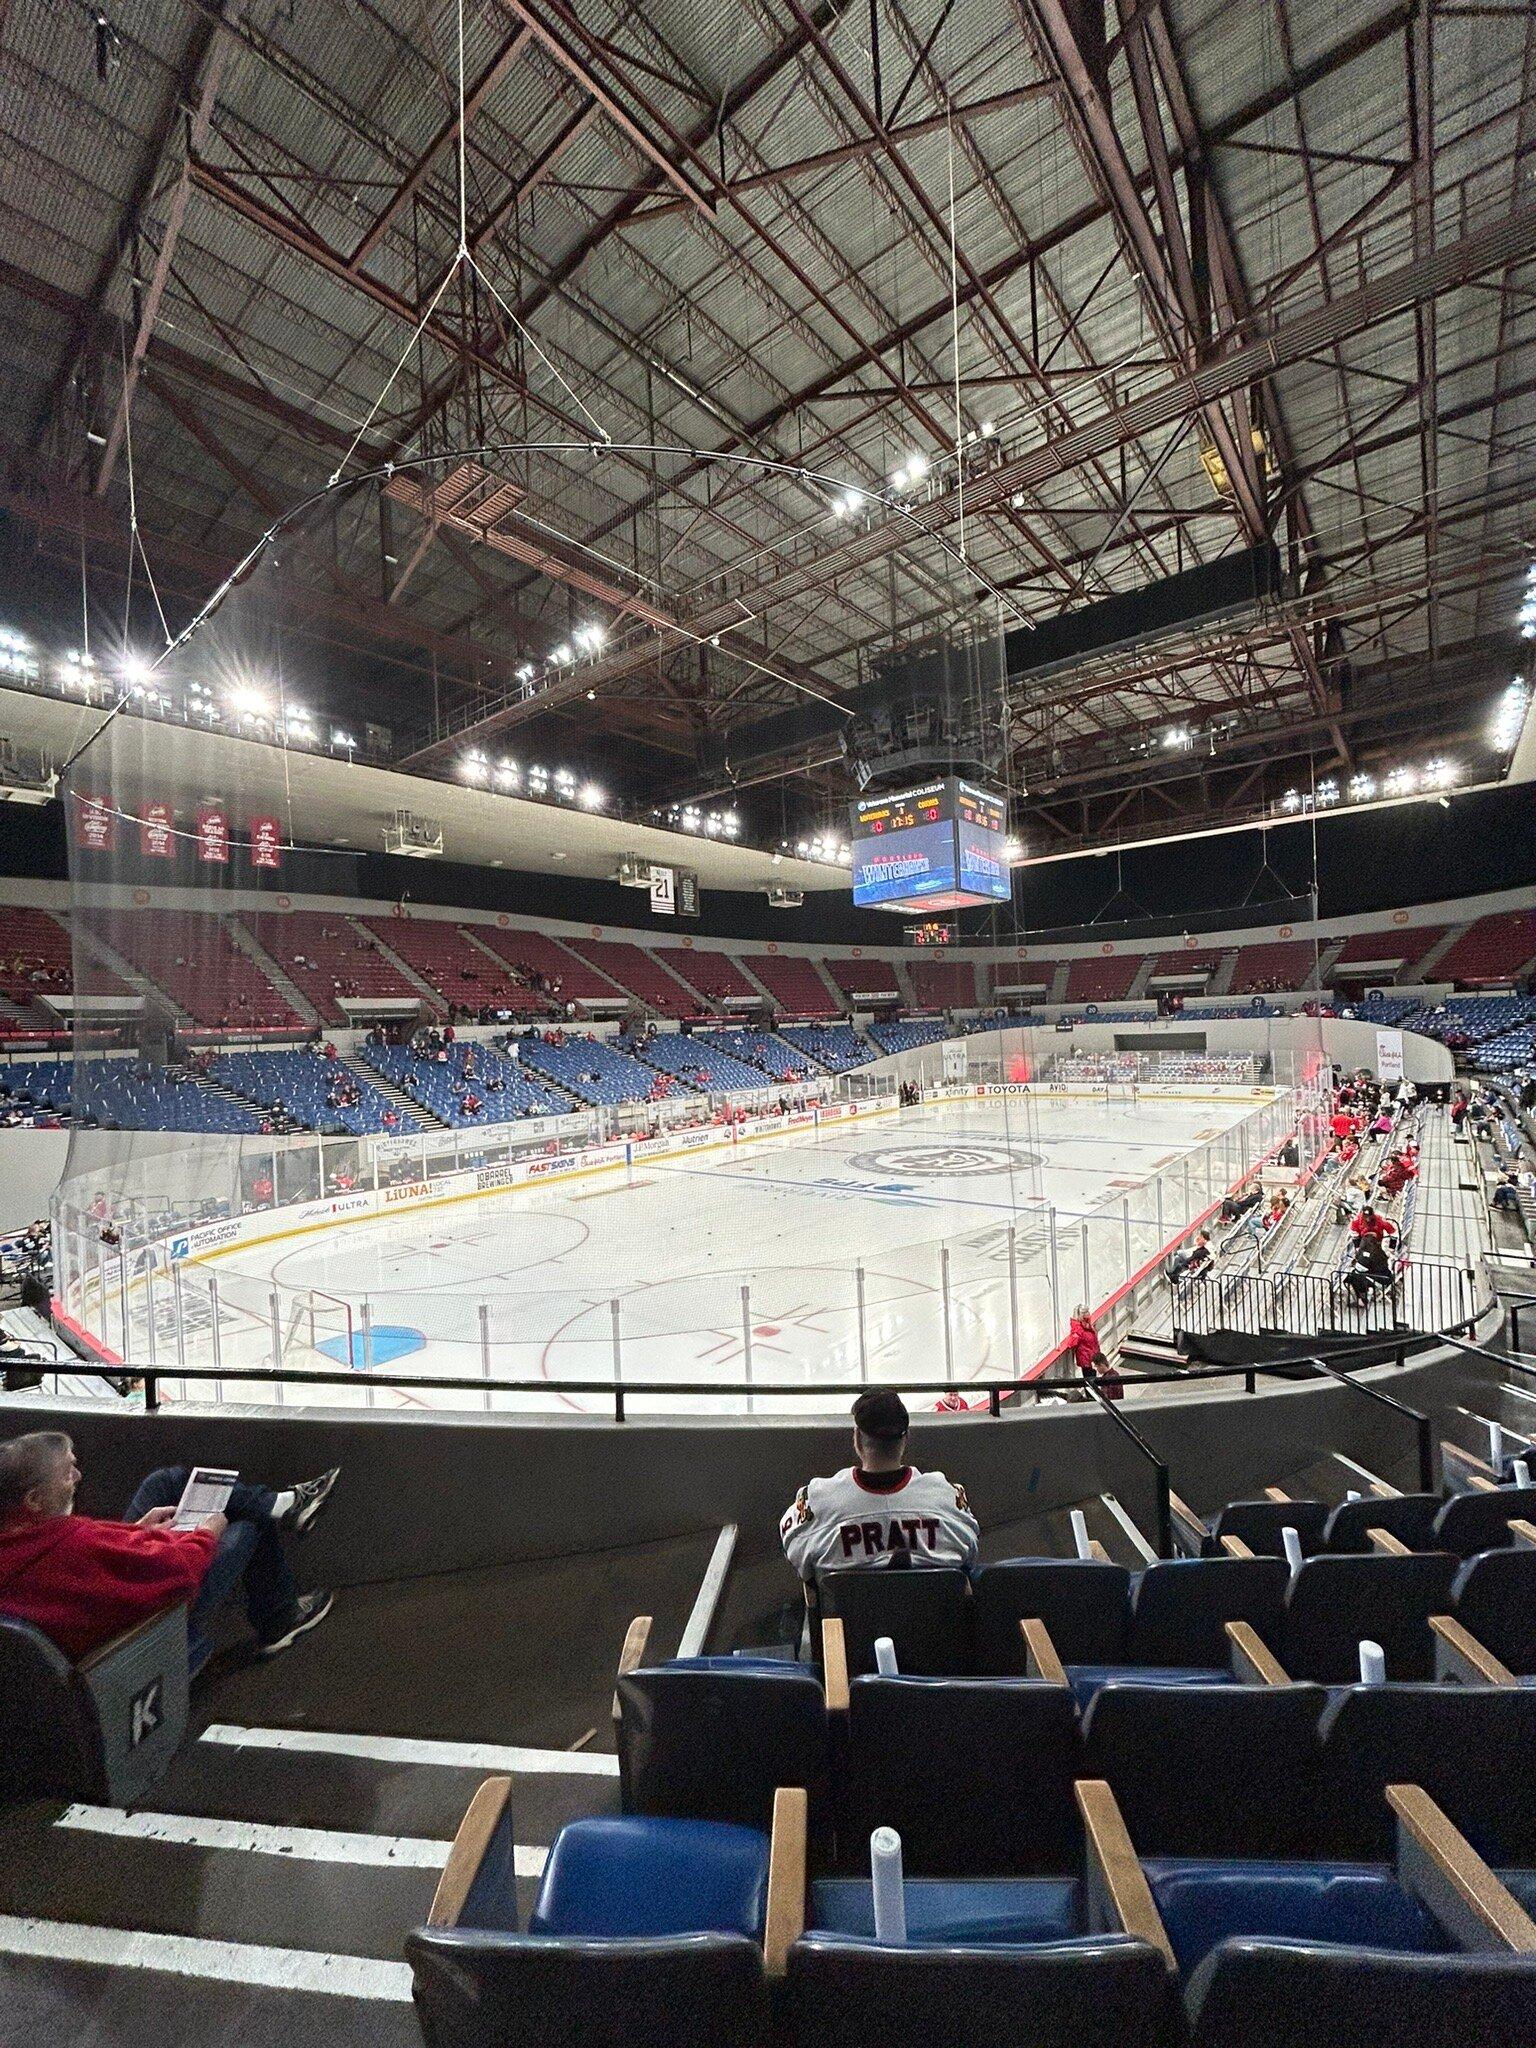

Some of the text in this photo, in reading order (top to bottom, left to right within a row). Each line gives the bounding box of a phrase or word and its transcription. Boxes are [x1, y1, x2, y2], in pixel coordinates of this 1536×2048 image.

[655, 878, 670, 898] 21
[1370, 993, 1381, 1001] 22
[1087, 1006, 1097, 1014] 20
[945, 1087, 969, 1098] xfinity
[987, 1085, 1031, 1094] TOYOTA
[528, 1157, 576, 1174] FASTSIGNS
[485, 1168, 512, 1180] BARREL
[385, 1183, 433, 1203] LiUNA!
[338, 1199, 370, 1211] ULTRA
[190, 1221, 242, 1242] PACIFIC OFFICE
[193, 1230, 238, 1248] AUTOMATION
[839, 1518, 941, 1558] PRATT
